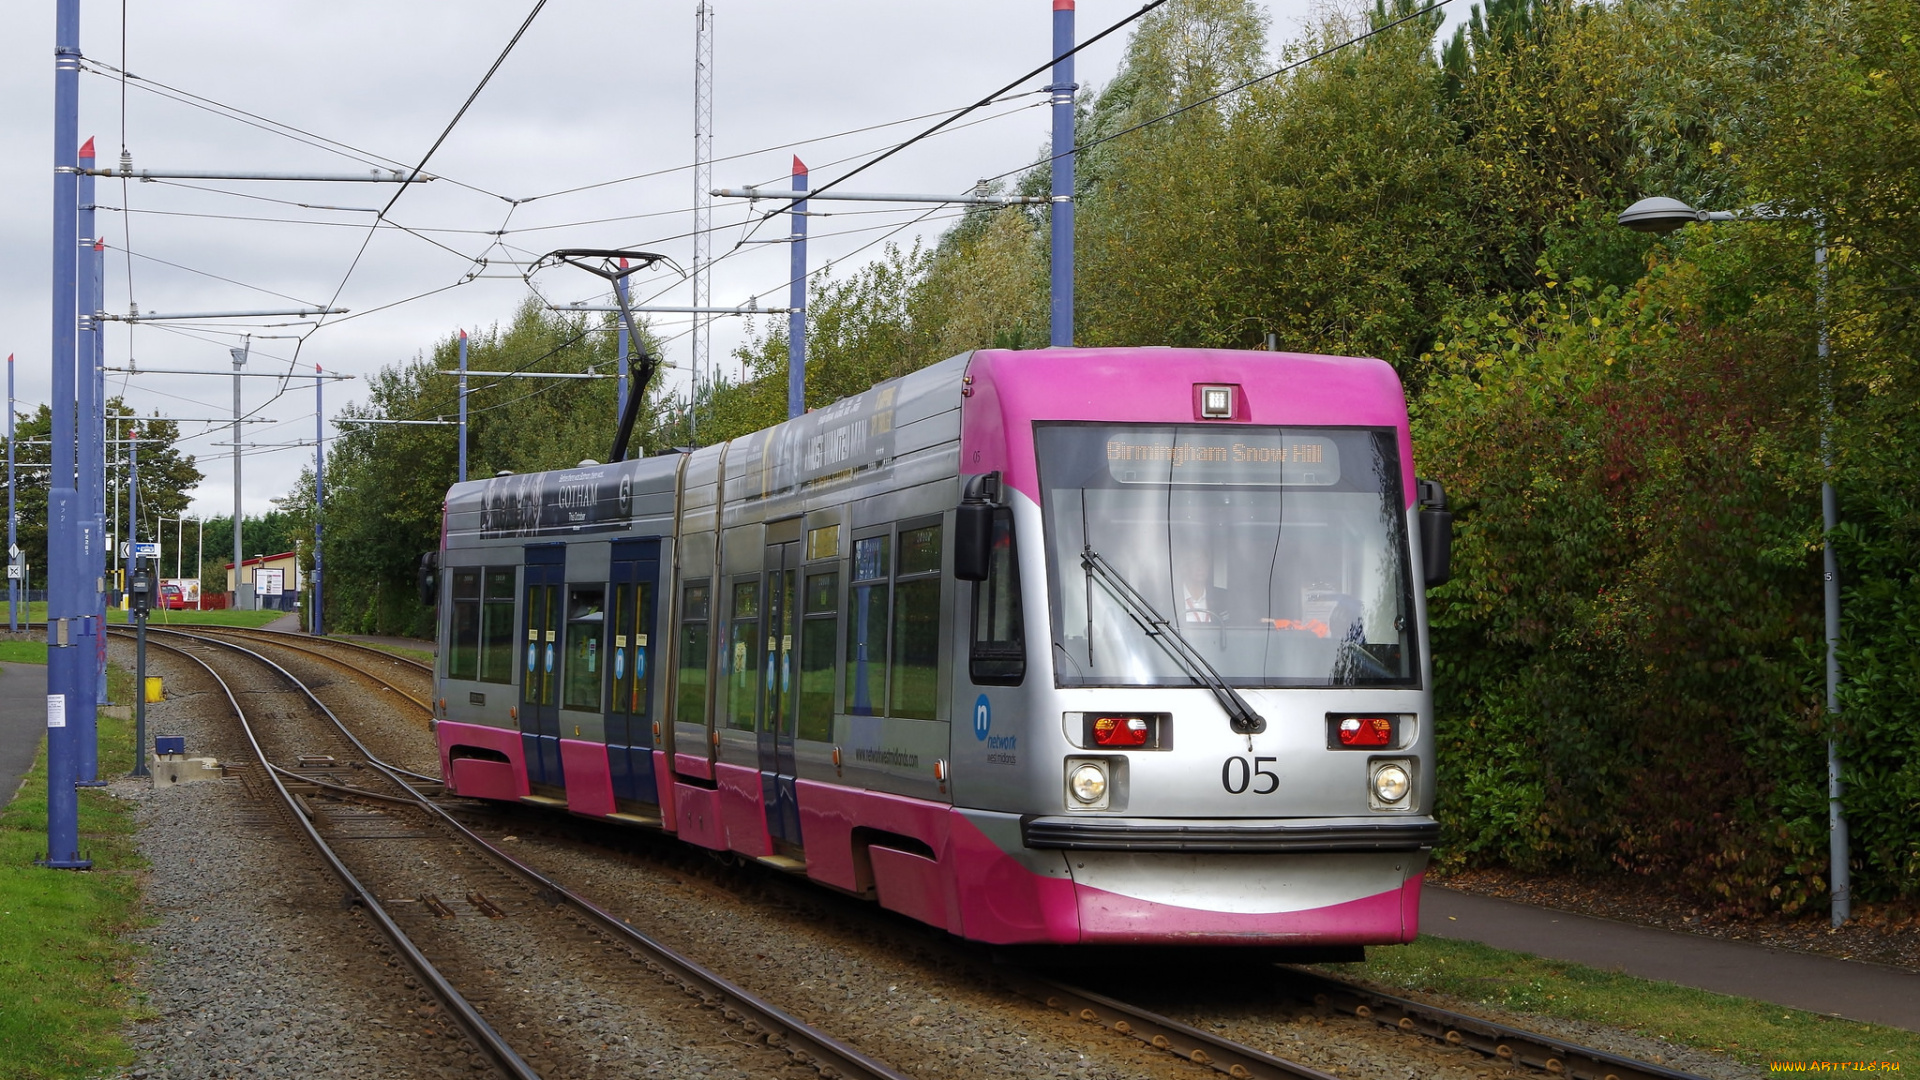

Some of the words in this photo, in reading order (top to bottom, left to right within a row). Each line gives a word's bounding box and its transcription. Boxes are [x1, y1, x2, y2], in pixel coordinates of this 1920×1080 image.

[1107, 441, 1227, 467] Birmingham
[1232, 443, 1288, 463] Snow
[1292, 444, 1322, 463] Hill
[558, 483, 599, 509] GOTHAM
[977, 705, 987, 730] n
[987, 734, 1017, 750] network
[1222, 756, 1280, 795] 05
